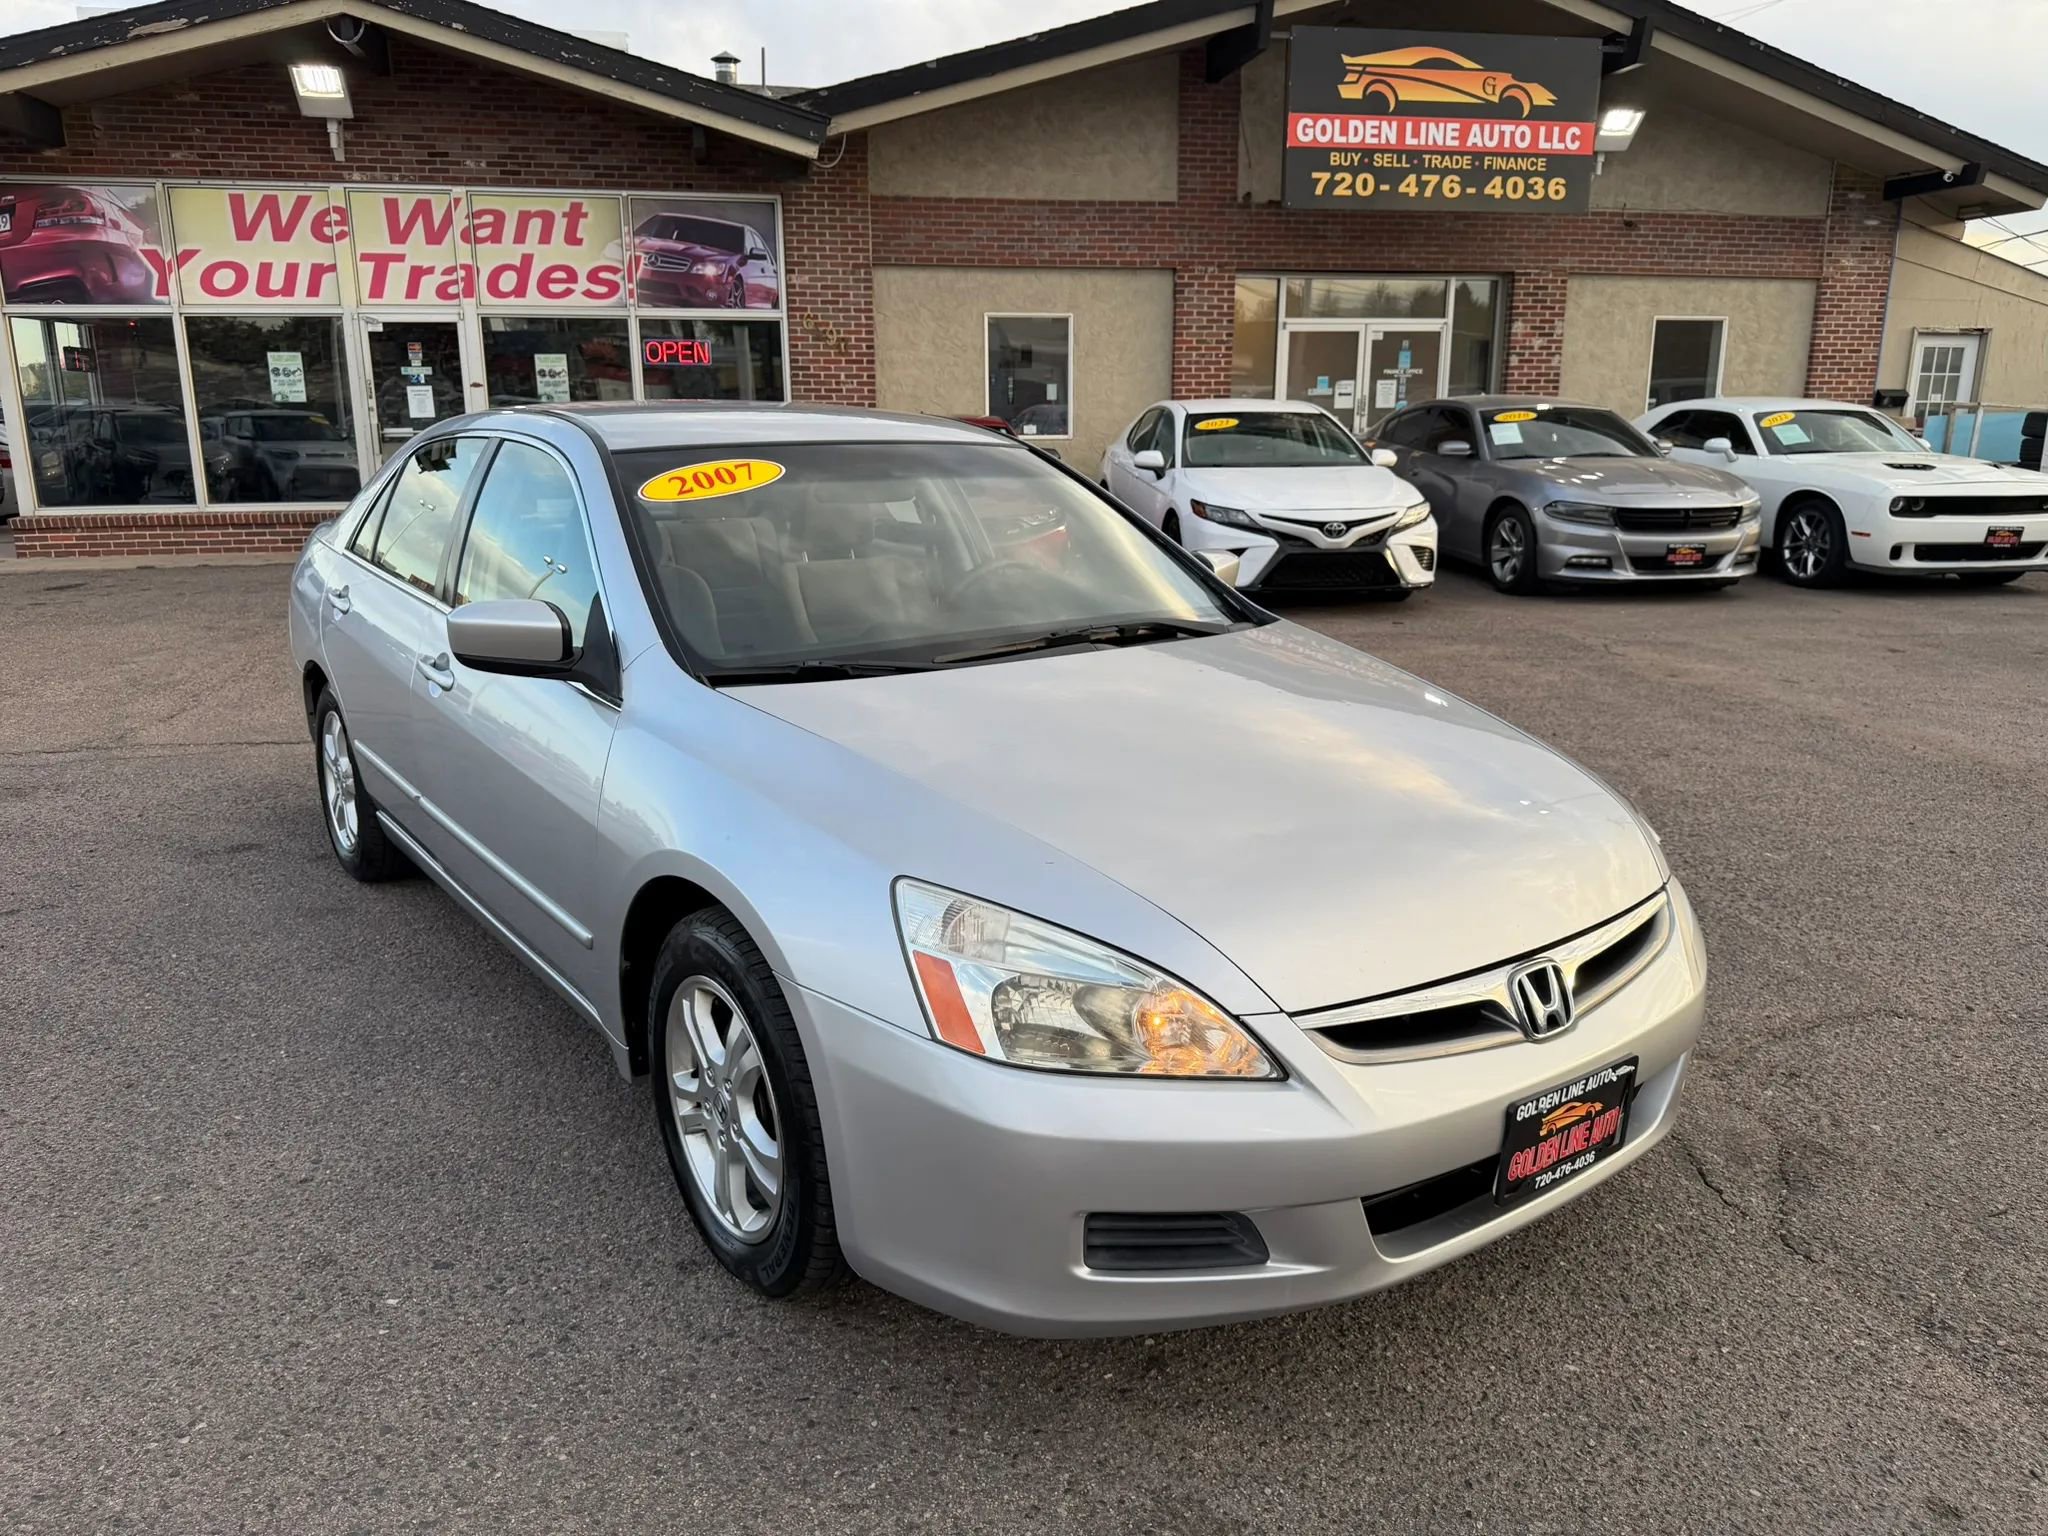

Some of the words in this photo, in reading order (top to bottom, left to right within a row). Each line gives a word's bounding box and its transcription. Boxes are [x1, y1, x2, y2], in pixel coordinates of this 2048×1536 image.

[1296, 117, 1398, 145] GOLDEN
[1404, 120, 1460, 147] LINE
[1466, 123, 1531, 148] AUTO
[1538, 125, 1581, 150] LLC
[1329, 152, 1362, 167] BUY
[1373, 153, 1410, 168] SELL
[1422, 154, 1472, 169] TRADE
[1483, 156, 1548, 171] FINANCE
[228, 193, 350, 244] We
[383, 197, 588, 247] Want
[139, 248, 338, 298] Your
[359, 252, 642, 300] Trades!
[645, 340, 710, 364] OPEN
[668, 462, 753, 496] 2007
[1516, 1090, 1561, 1121] GOLDEN
[1561, 1081, 1585, 1102] LINE
[1585, 1068, 1613, 1092] AUTO
[1508, 1132, 1561, 1181] GOLDEN
[1560, 1120, 1591, 1159] LINE
[1534, 1150, 1596, 1189] 720-476-4036
